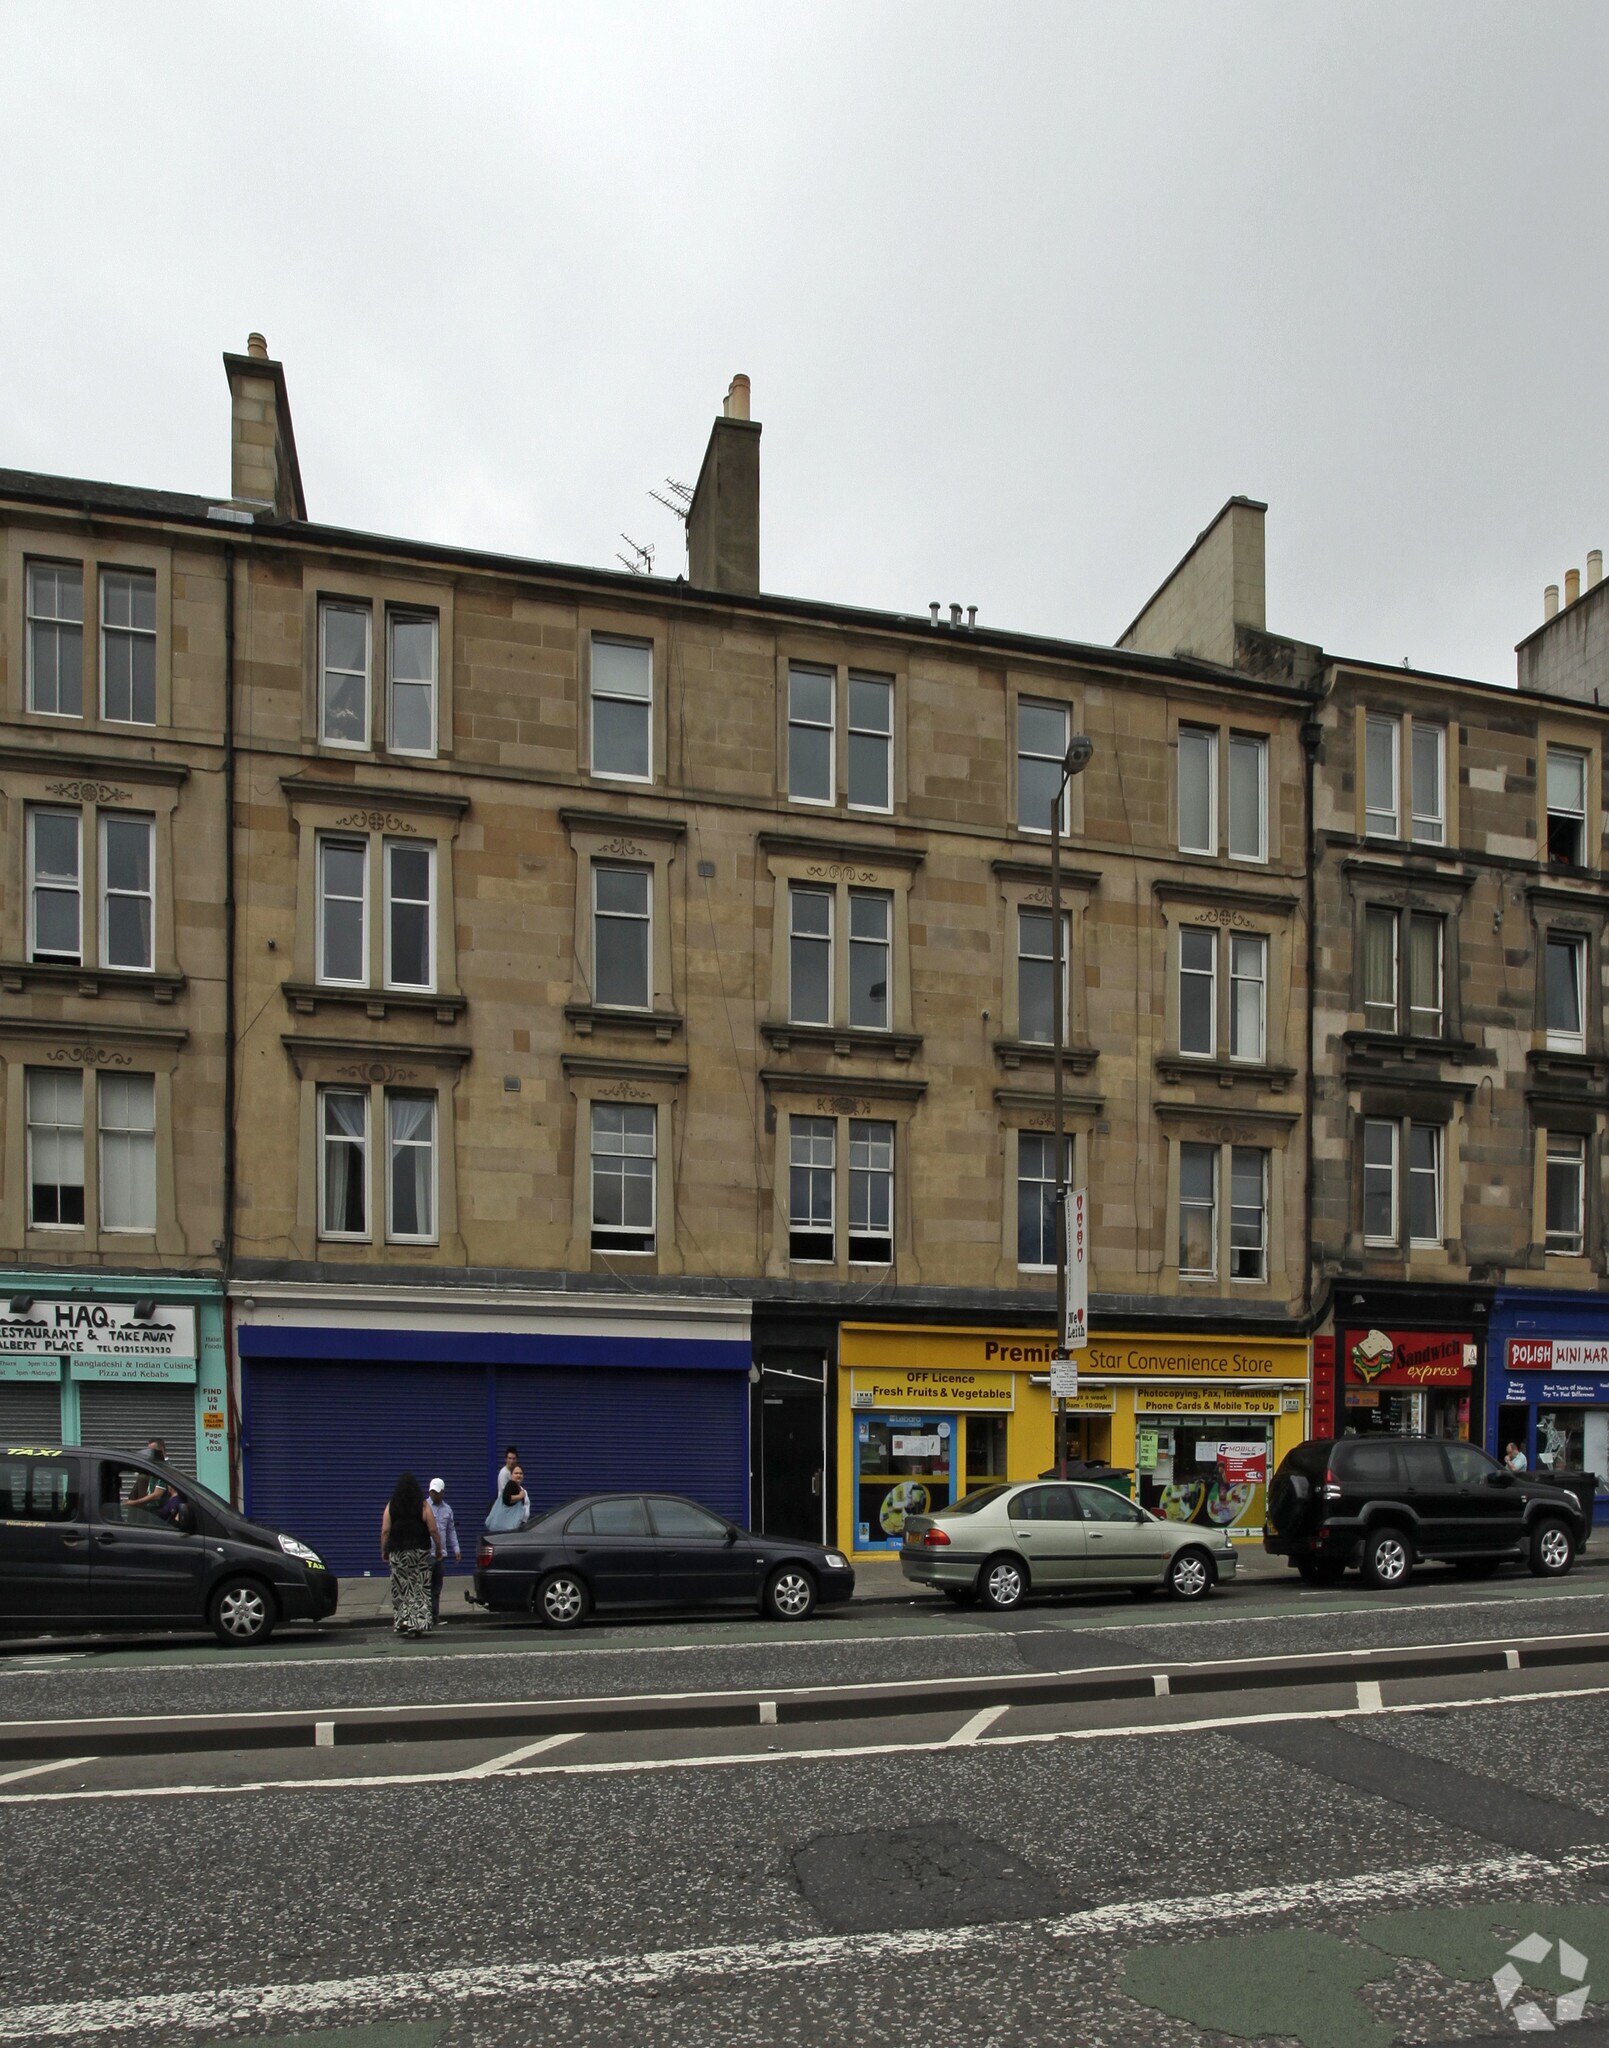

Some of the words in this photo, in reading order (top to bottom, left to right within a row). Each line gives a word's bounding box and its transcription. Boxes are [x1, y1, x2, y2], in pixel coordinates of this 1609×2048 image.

[87, 1329, 99, 1341] &
[1067, 1325, 1085, 1338] Leith
[0, 1340, 36, 1351] ALBERT
[45, 1340, 84, 1352] PLACE
[985, 1341, 1073, 1362] Premier
[1090, 1350, 1122, 1370] Star
[1127, 1351, 1228, 1372] Convenience
[1233, 1354, 1273, 1373] Store
[1396, 1340, 1460, 1370] Sandwich
[1512, 1344, 1551, 1365] POLISH
[1556, 1346, 1581, 1364] MINI
[1583, 1346, 1609, 1364] MAR
[74, 1360, 122, 1369] Bangladeshi
[164, 1362, 193, 1370] Cuisine
[99, 1369, 119, 1377] Pizza
[907, 1372, 929, 1382] OFF
[932, 1372, 975, 1383] Licence
[1407, 1365, 1459, 1383] express
[873, 1386, 903, 1396] Fresh
[906, 1387, 938, 1397] Fruits
[940, 1388, 948, 1397] &
[951, 1388, 1012, 1400] Vegetables
[1138, 1389, 1201, 1399] Photocopying,
[1203, 1389, 1221, 1399] Fax,
[1223, 1389, 1280, 1398] International
[1146, 1401, 1173, 1410] Phone
[1176, 1401, 1201, 1410] Cards
[1204, 1402, 1210, 1410] &
[1213, 1401, 1242, 1410] Mobile
[1245, 1402, 1260, 1411] Top
[1262, 1402, 1274, 1411] Up
[895, 1415, 922, 1423] Lebara
[7, 1448, 63, 1457] TAXI
